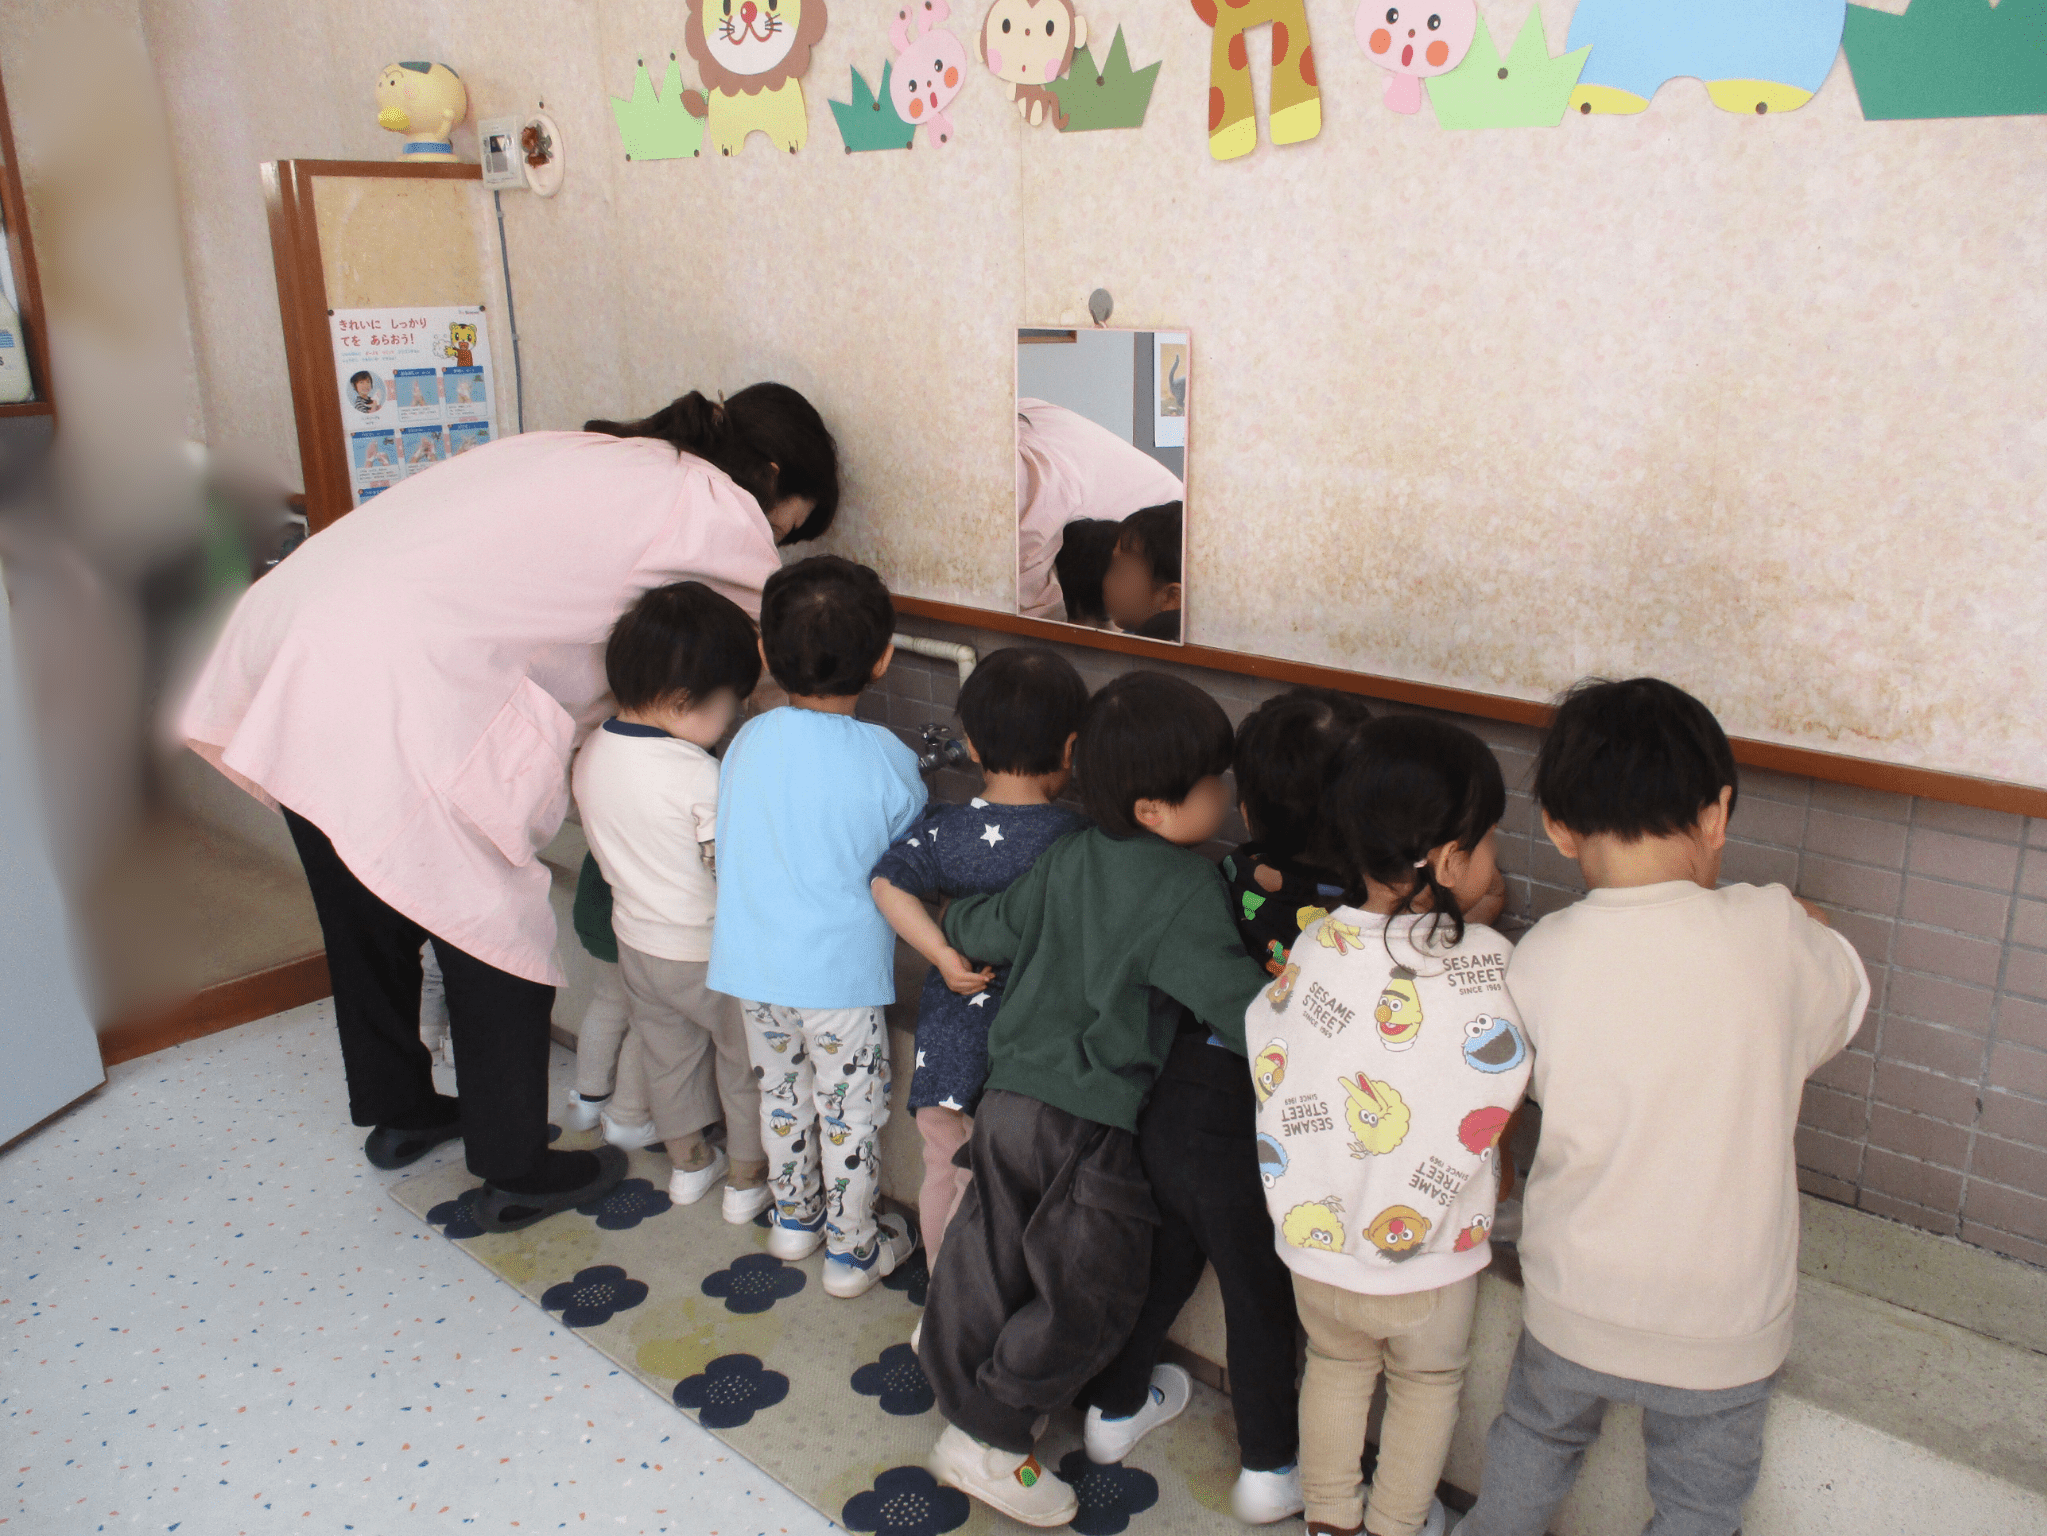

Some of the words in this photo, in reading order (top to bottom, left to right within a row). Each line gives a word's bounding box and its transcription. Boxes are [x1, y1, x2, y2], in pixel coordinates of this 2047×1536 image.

[339, 319, 382, 332] きれいに
[391, 317, 427, 330] しっかり
[340, 335, 361, 347] てを
[370, 333, 415, 346] あらおう!
[1442, 953, 1504, 971] SESAME
[1447, 967, 1505, 987] STREET
[1459, 985, 1483, 995] SINCE
[1486, 983, 1502, 991] 1969
[1309, 981, 1356, 1024] SESAME
[1302, 994, 1347, 1035] STREET
[1302, 1010, 1319, 1028] SINCE
[1299, 1093, 1318, 1103] SINCE
[1281, 1101, 1329, 1122] STREET
[1282, 1117, 1334, 1137] SESAME
[1415, 1161, 1461, 1194] TREET
[1445, 1165, 1469, 1181] SINCE
[1408, 1174, 1456, 1207] SAME
